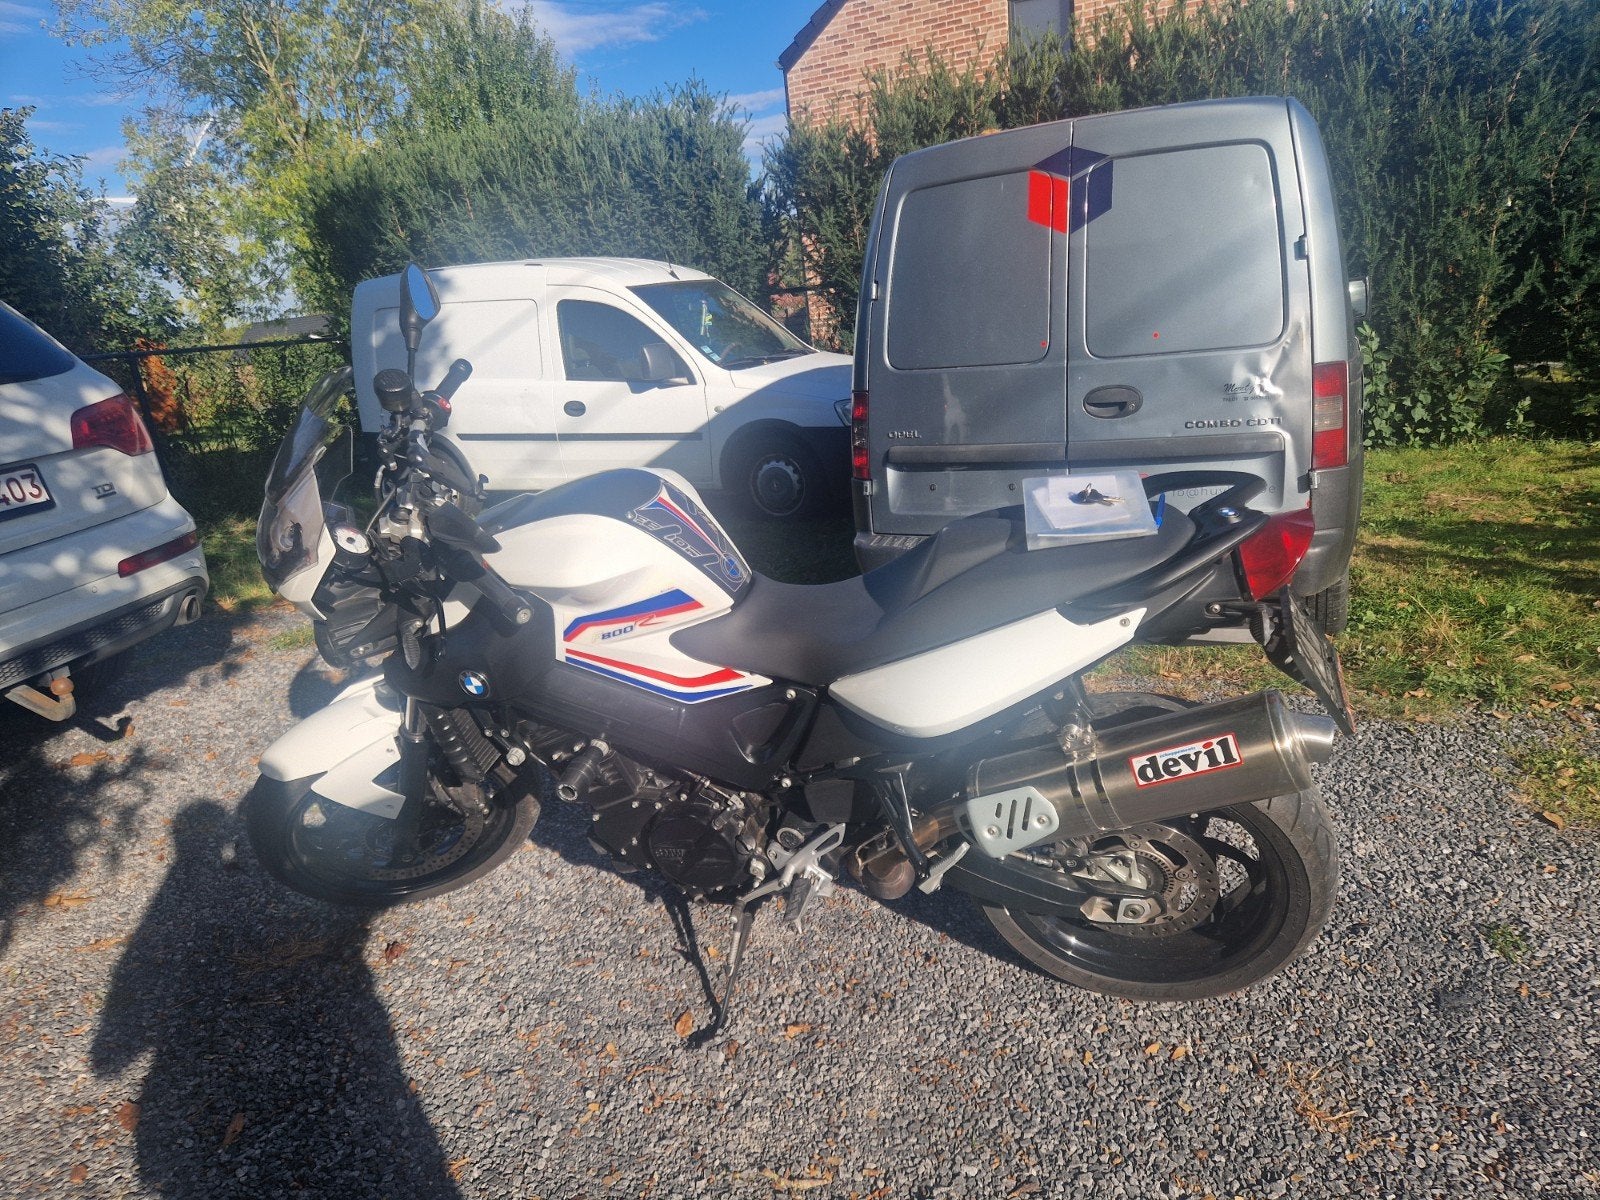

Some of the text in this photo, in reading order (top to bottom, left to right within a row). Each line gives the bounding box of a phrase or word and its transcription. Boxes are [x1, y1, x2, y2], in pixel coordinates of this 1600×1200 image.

[1184, 416, 1283, 429] COMBO CDTI
[888, 429, 923, 439] OPEL
[91, 481, 116, 495] TDI
[601, 624, 634, 640] 800
[1137, 737, 1238, 783] devil
